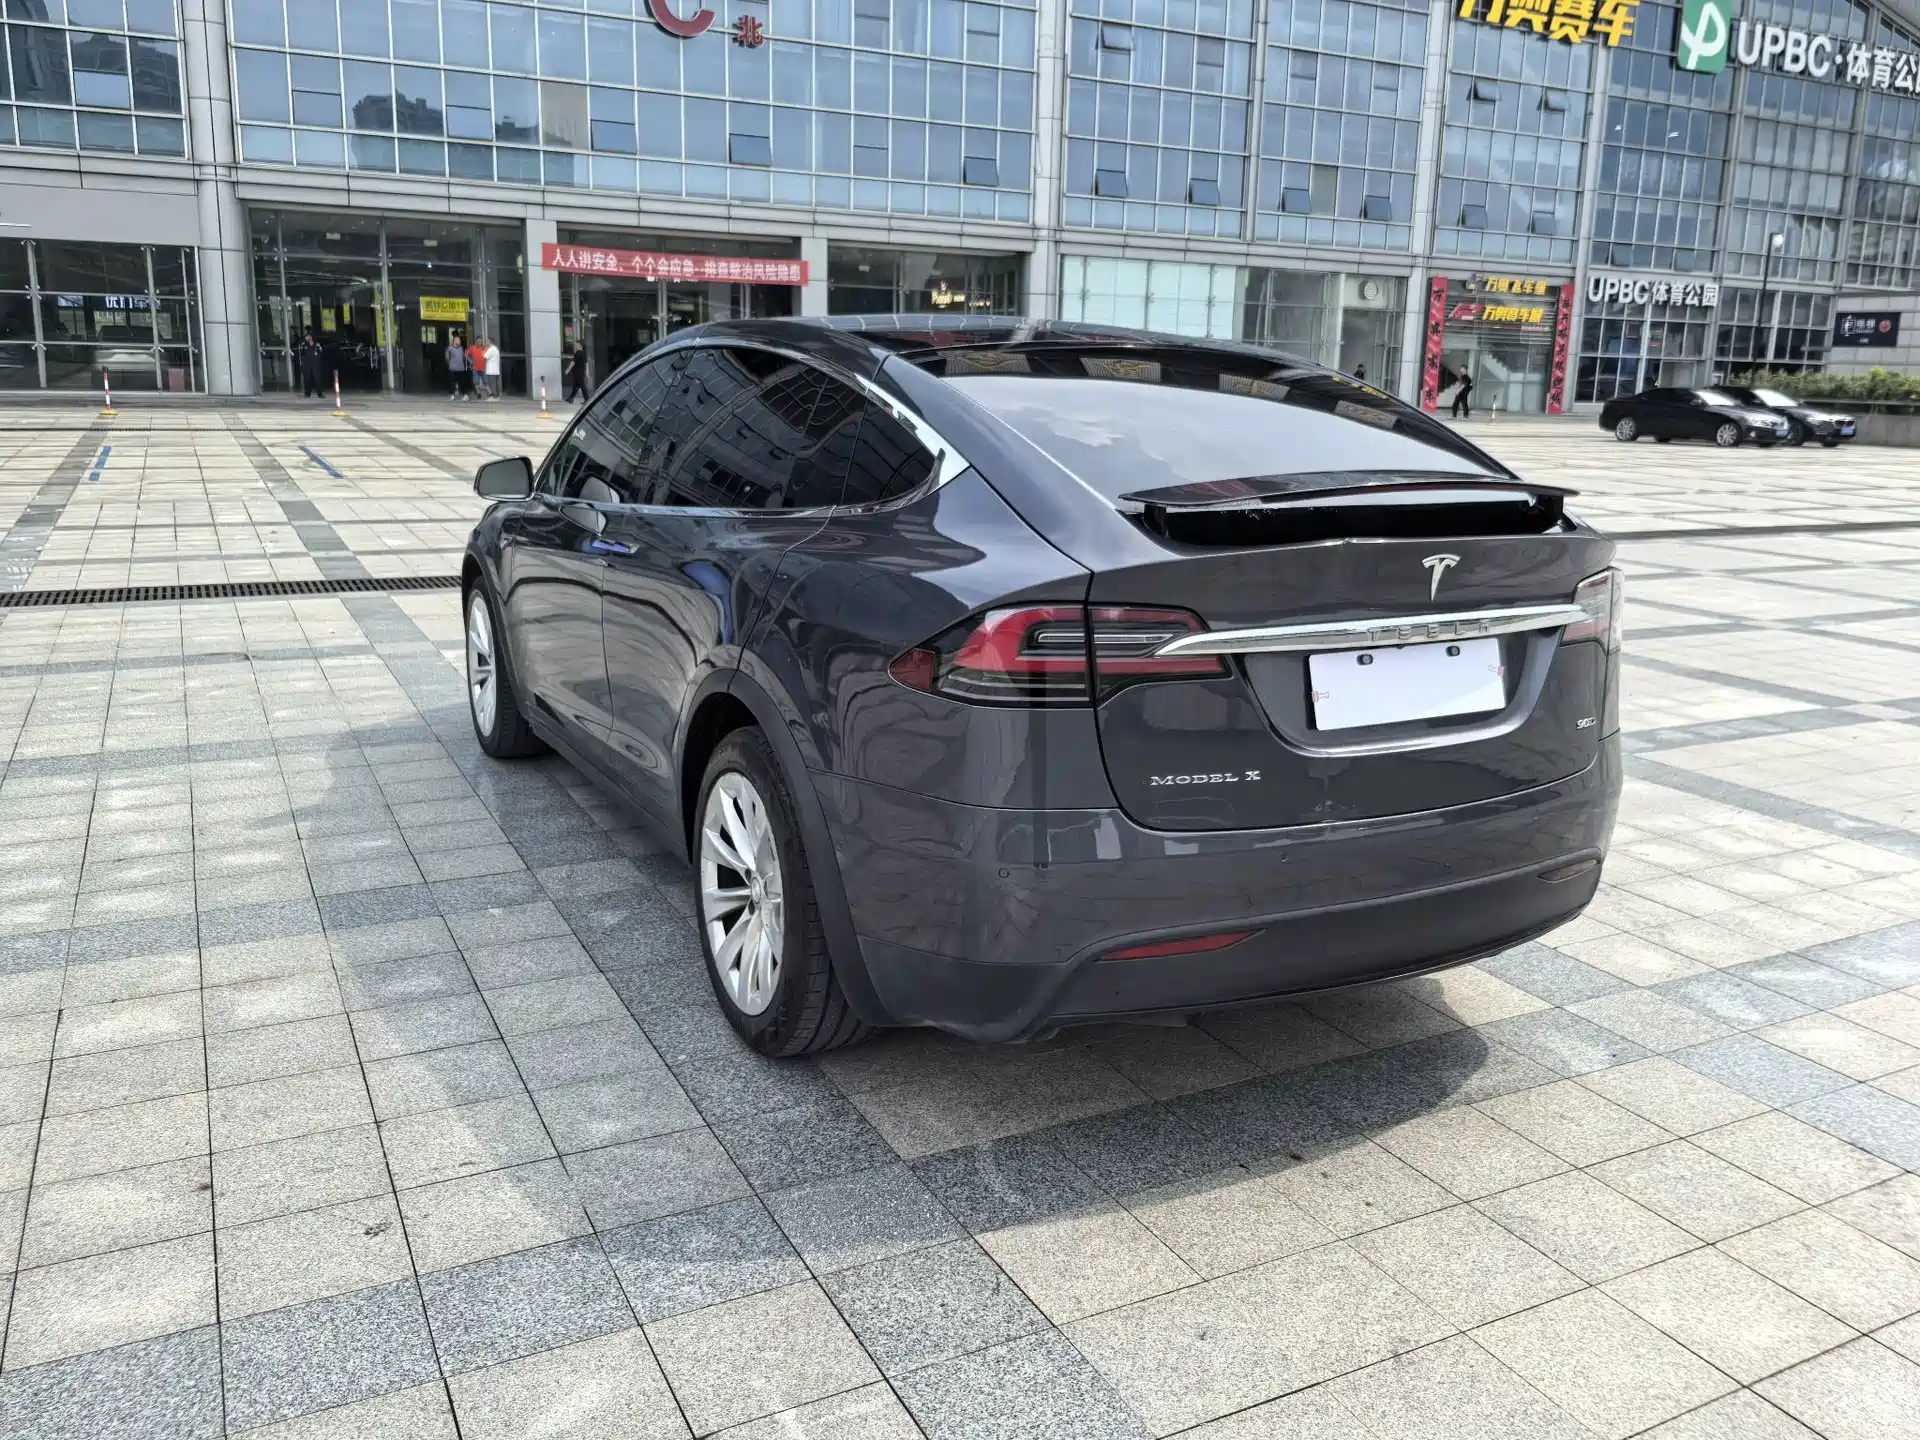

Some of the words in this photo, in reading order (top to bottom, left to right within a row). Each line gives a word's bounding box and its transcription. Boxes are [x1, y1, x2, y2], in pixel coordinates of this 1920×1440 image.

[1367, 619, 1490, 642] TESLA
[1150, 773, 1240, 786] MODEL
[1245, 770, 1261, 781] X
